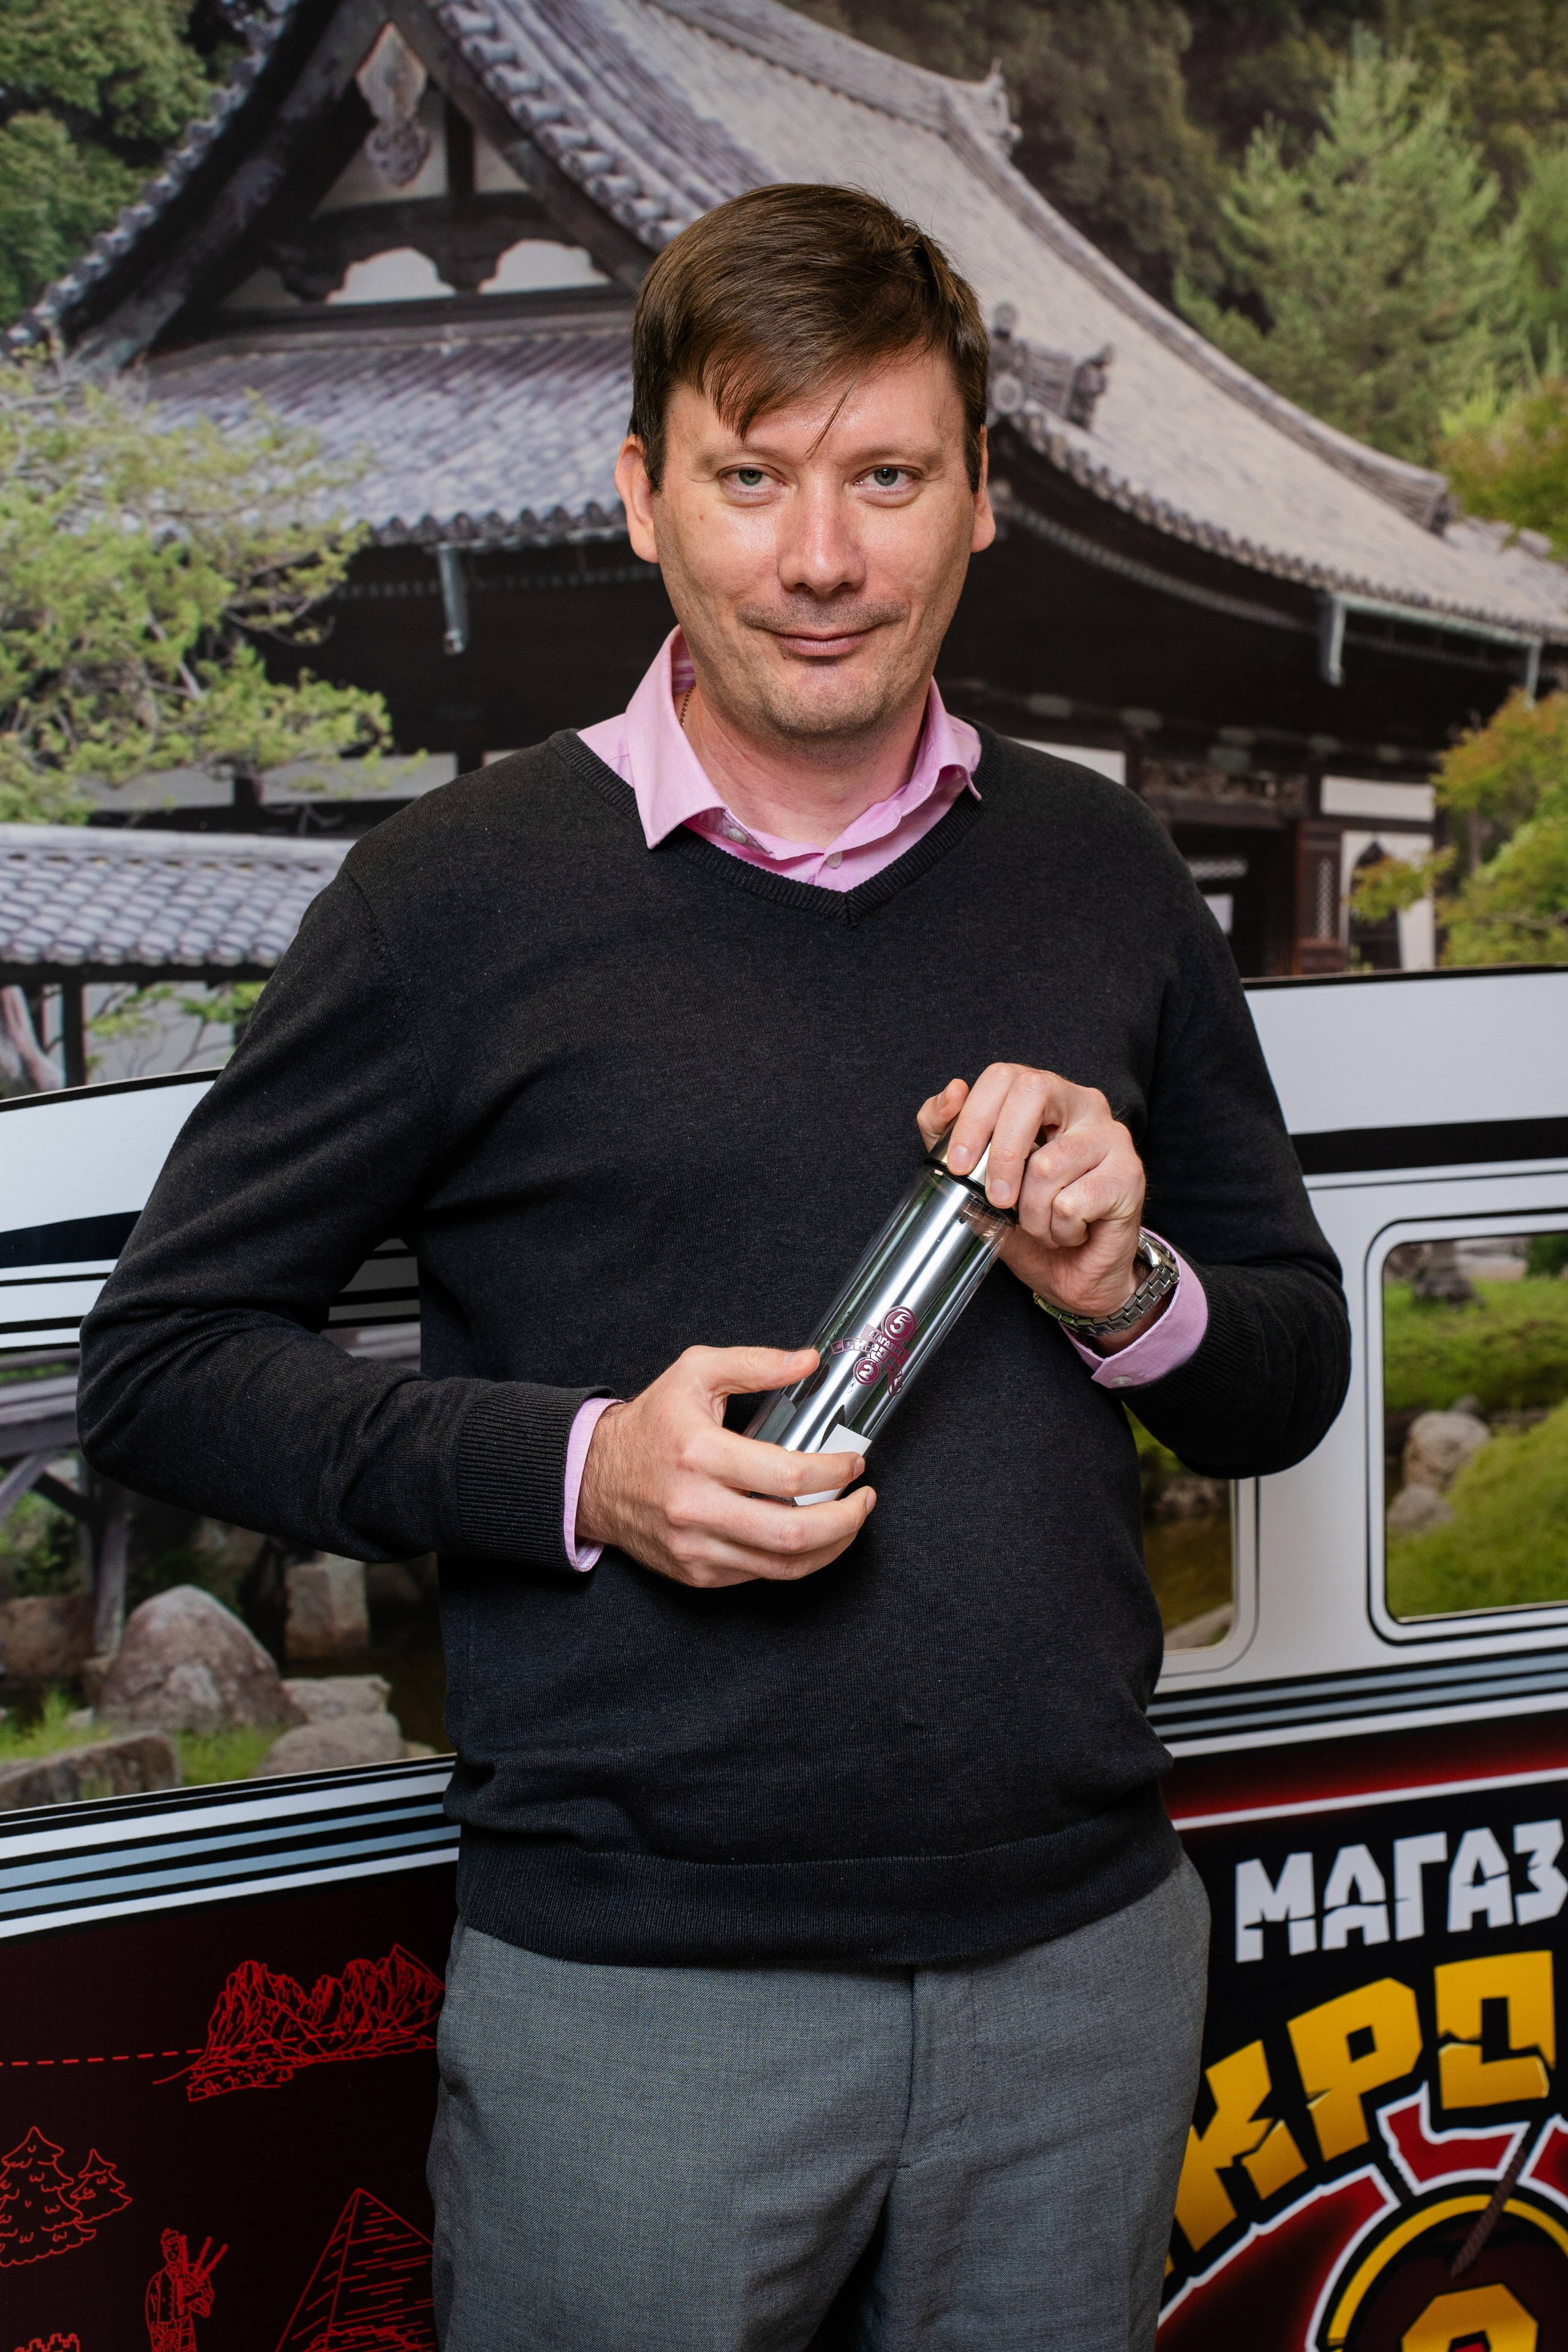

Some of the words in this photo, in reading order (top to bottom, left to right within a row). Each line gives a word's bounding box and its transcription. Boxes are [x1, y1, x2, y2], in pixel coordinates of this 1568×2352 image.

[889, 1313, 913, 1334] 5
[1235, 1819, 1568, 1962] МАГАЗ
[1164, 1950, 1556, 2281] КРО
